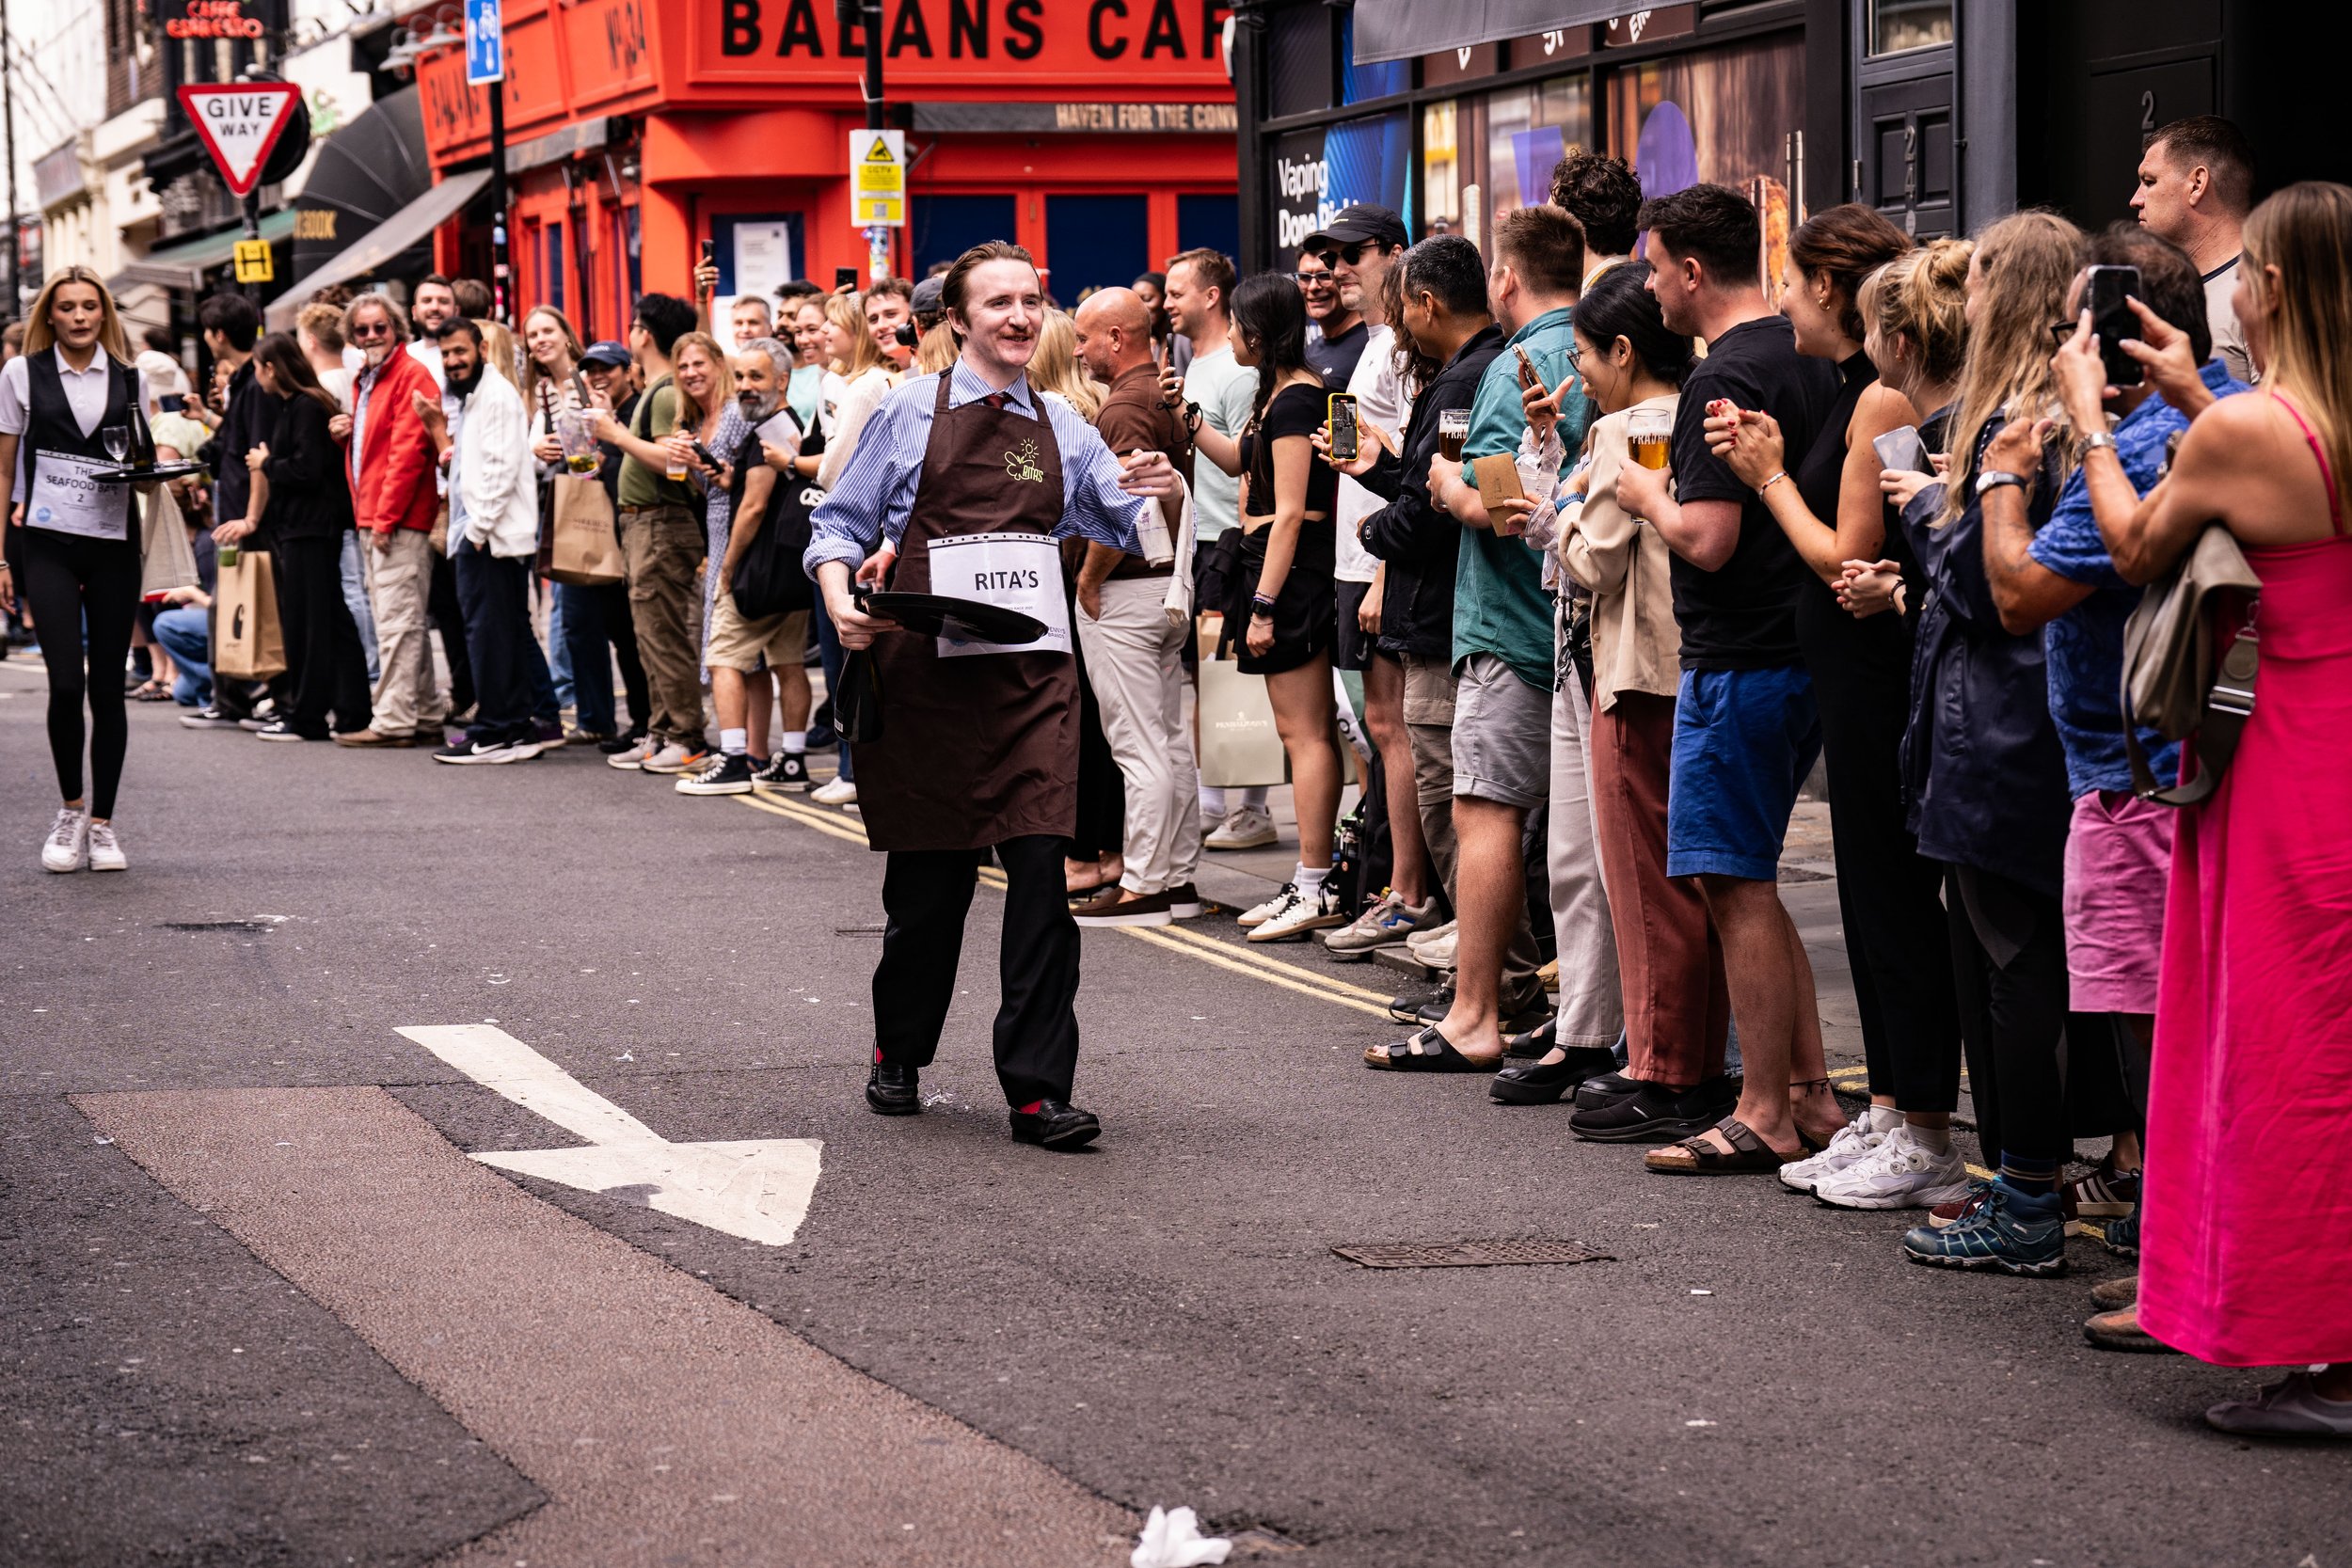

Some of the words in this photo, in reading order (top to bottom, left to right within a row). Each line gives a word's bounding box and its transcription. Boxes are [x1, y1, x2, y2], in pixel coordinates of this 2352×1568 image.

[722, 0, 1042, 59] BALANS
[207, 97, 272, 118] GIVE
[1055, 103, 1114, 129] HAVEN
[1118, 103, 1153, 130] FOR
[1154, 103, 1189, 130] THE
[219, 123, 260, 136] WAY
[1278, 153, 1329, 203] Vaping
[1279, 208, 1318, 248] Done
[241, 245, 266, 276] H
[1632, 433, 1669, 445] PRAVHA
[74, 466, 94, 477] THE
[1023, 465, 1044, 483] RITAS
[46, 474, 95, 491] SEAFOOD
[77, 494, 84, 502] 2
[975, 570, 1039, 591] RITA'S
[1047, 626, 1066, 635] ENNYS
